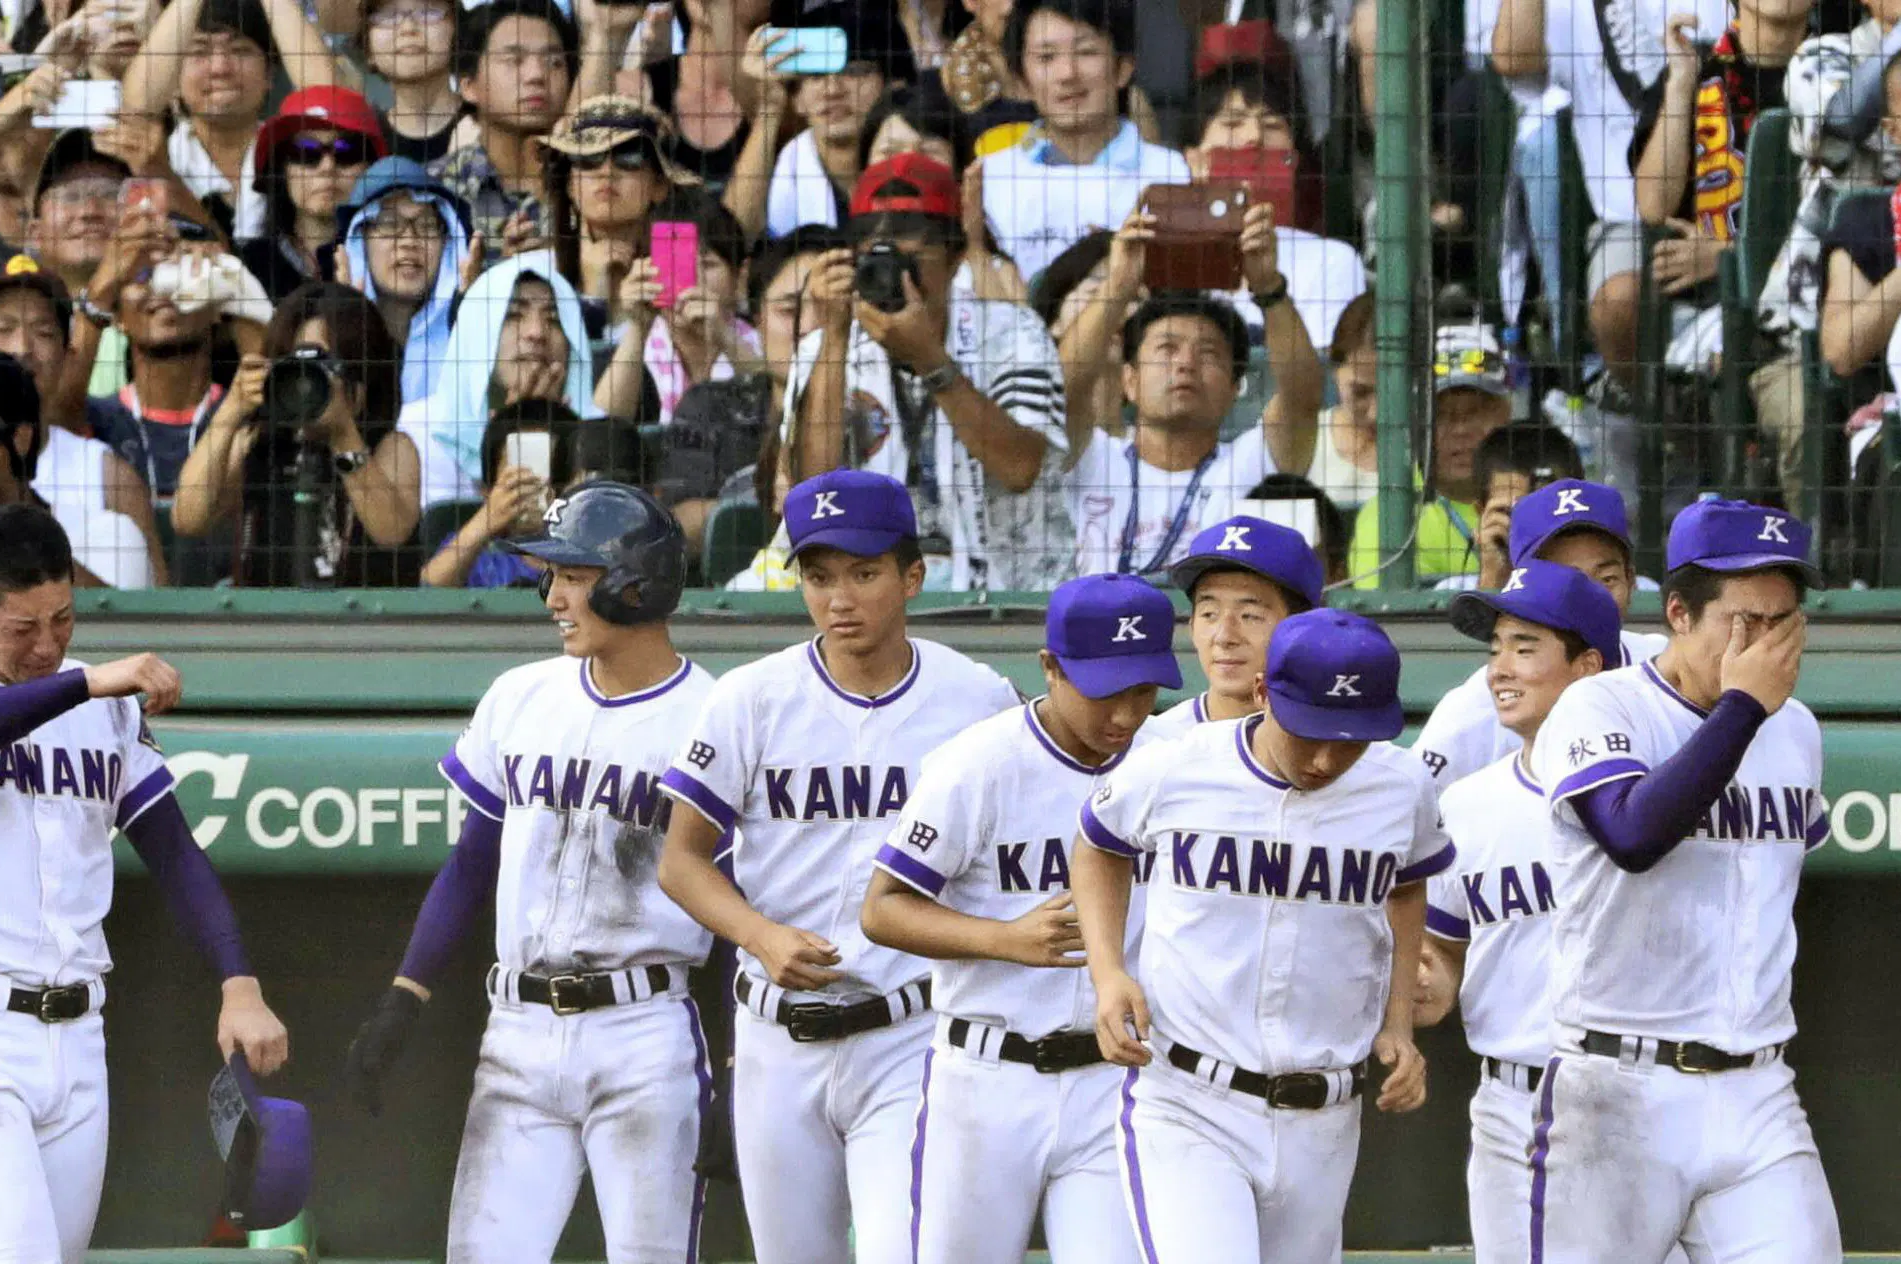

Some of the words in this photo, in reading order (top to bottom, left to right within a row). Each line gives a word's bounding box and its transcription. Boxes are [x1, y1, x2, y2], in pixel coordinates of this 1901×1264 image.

[543, 498, 568, 523] K
[811, 491, 845, 520] K
[1553, 489, 1589, 515] K
[1216, 526, 1252, 551] K
[1757, 515, 1790, 544] K
[1500, 567, 1526, 591] K
[1111, 615, 1147, 642] K
[1325, 674, 1362, 697] K
[1567, 732, 1632, 766] 秋田
